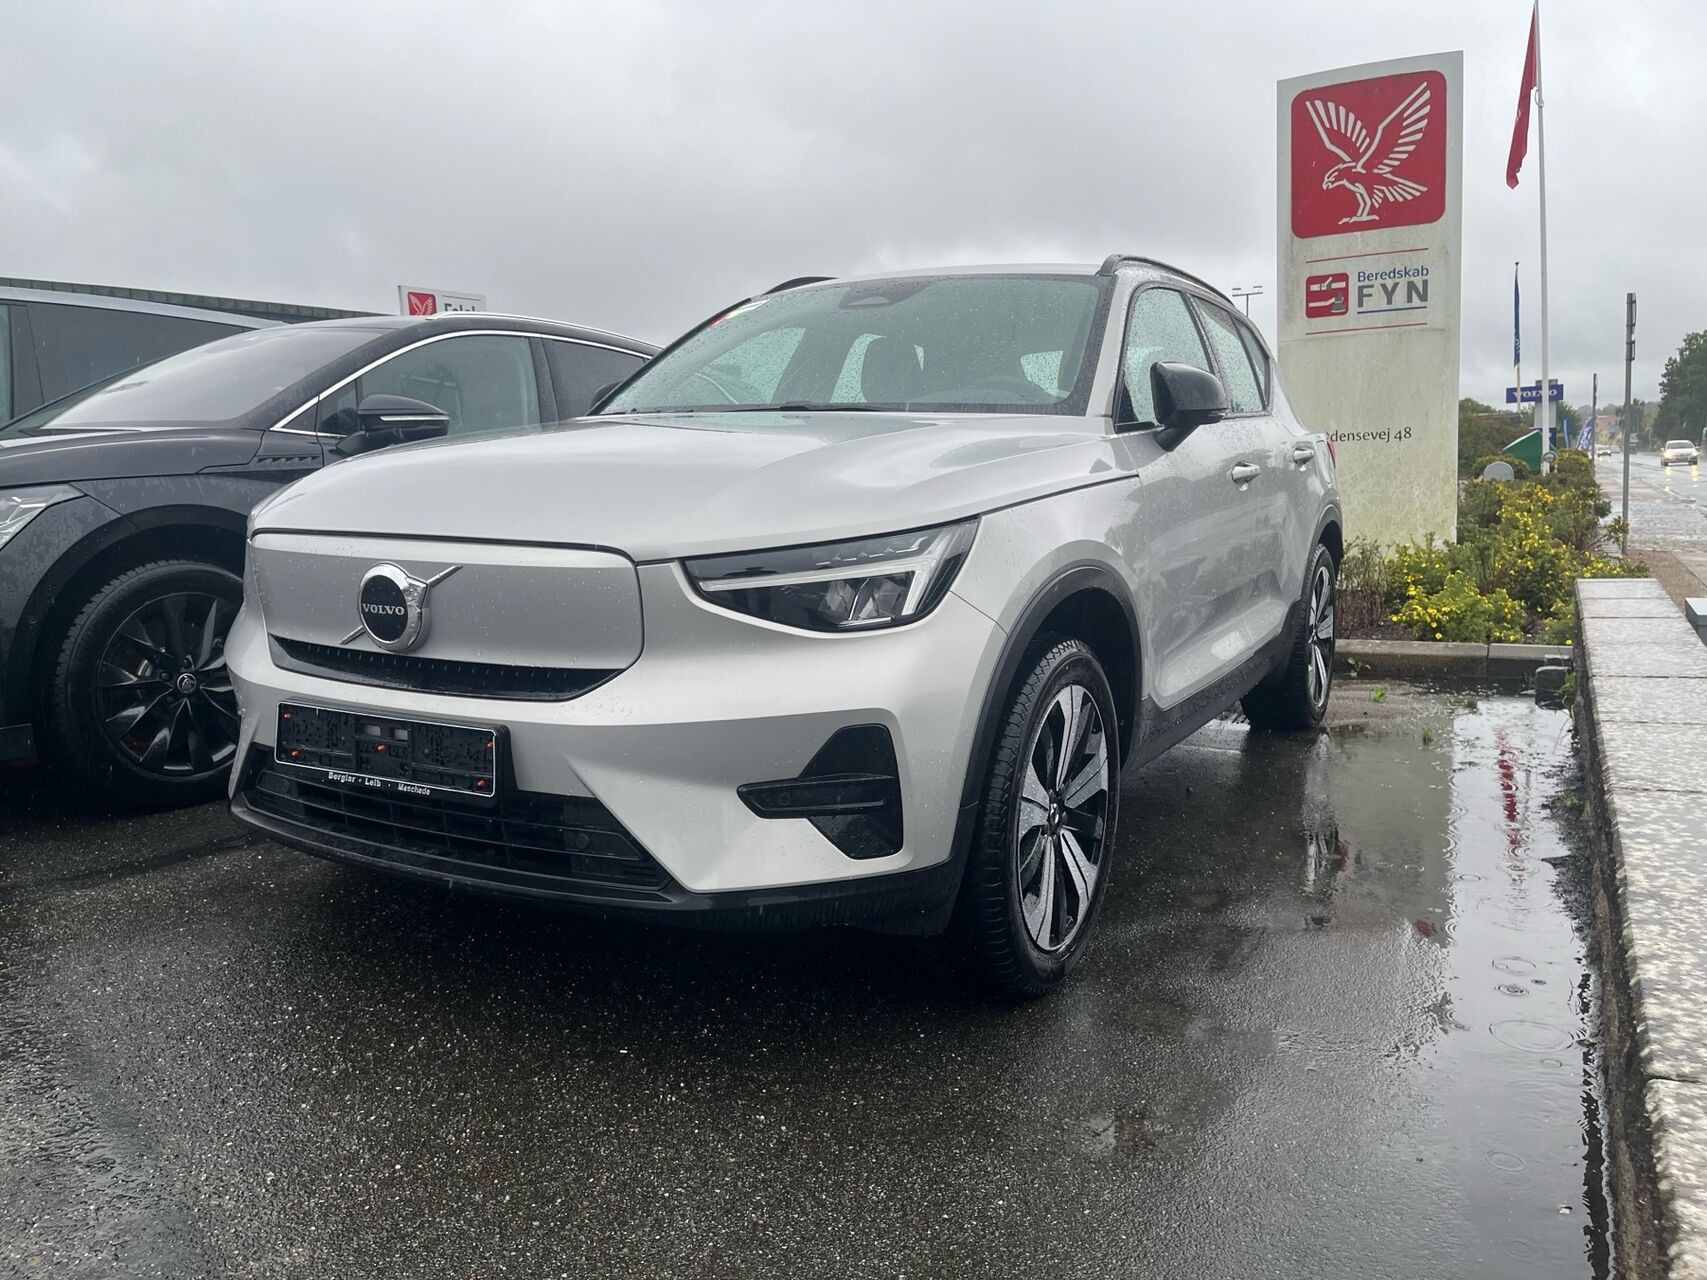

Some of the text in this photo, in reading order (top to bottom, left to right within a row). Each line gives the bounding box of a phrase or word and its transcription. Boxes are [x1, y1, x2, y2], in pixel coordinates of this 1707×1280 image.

[1357, 265, 1429, 283] Beredskab
[1357, 279, 1429, 308] FYN
[1512, 389, 1558, 399] VOLO
[1394, 426, 1412, 441] 48
[361, 603, 405, 616] VOLVO
[397, 783, 431, 796] Meschede
